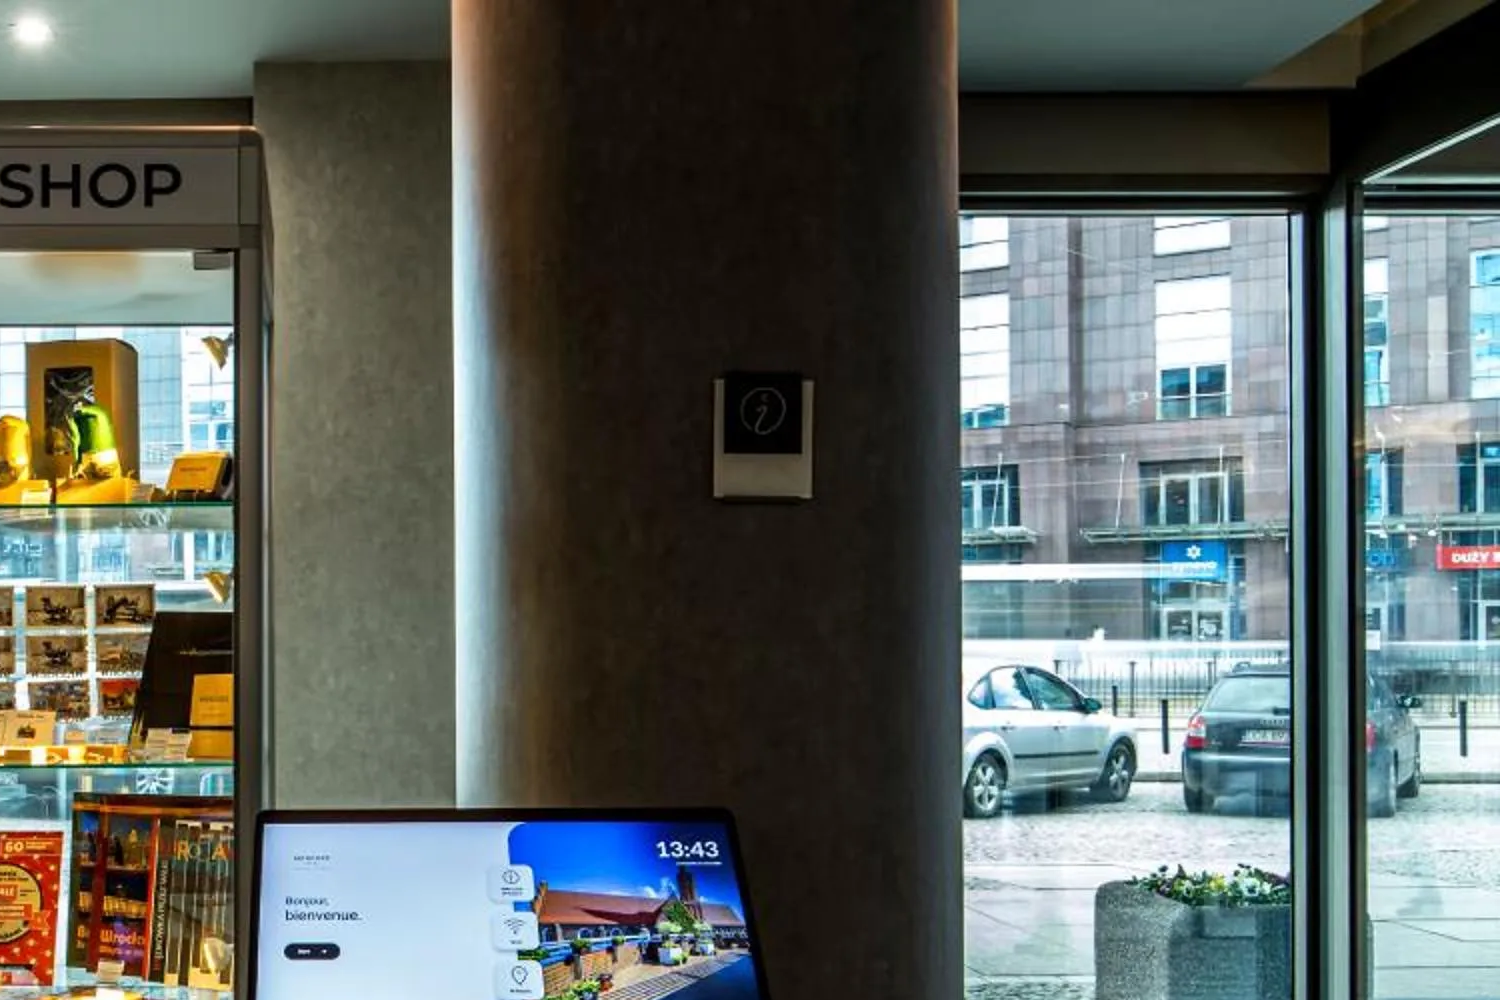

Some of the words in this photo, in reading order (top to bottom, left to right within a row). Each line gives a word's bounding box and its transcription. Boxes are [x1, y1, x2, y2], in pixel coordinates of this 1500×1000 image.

[5, 841, 25, 852] 60
[656, 841, 719, 858] 13:43
[285, 896, 330, 907] Bonjour,
[285, 910, 363, 921] bienvenue.
